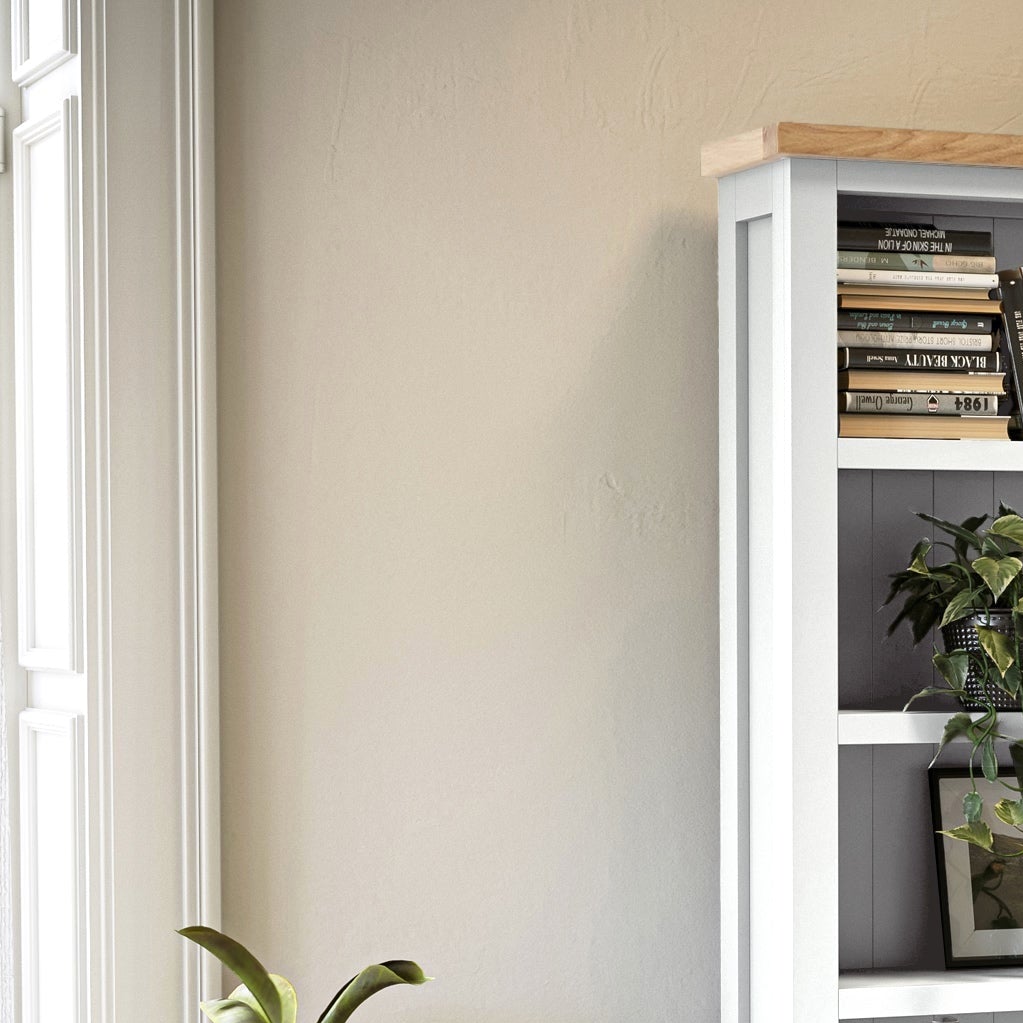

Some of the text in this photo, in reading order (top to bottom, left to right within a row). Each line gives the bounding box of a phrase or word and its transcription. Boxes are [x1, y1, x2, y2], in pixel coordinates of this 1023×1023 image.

[886, 228, 946, 239] MICHAEL ONDAATJE
[878, 239, 895, 250] LION
[901, 240, 912, 250] OF
[912, 240, 932, 252] SKIN
[932, 241, 945, 252] THE
[945, 242, 953, 252] IN
[905, 354, 987, 369] BLACK BEAUTY
[855, 394, 913, 411] George Orwell
[955, 397, 988, 411] 1984
